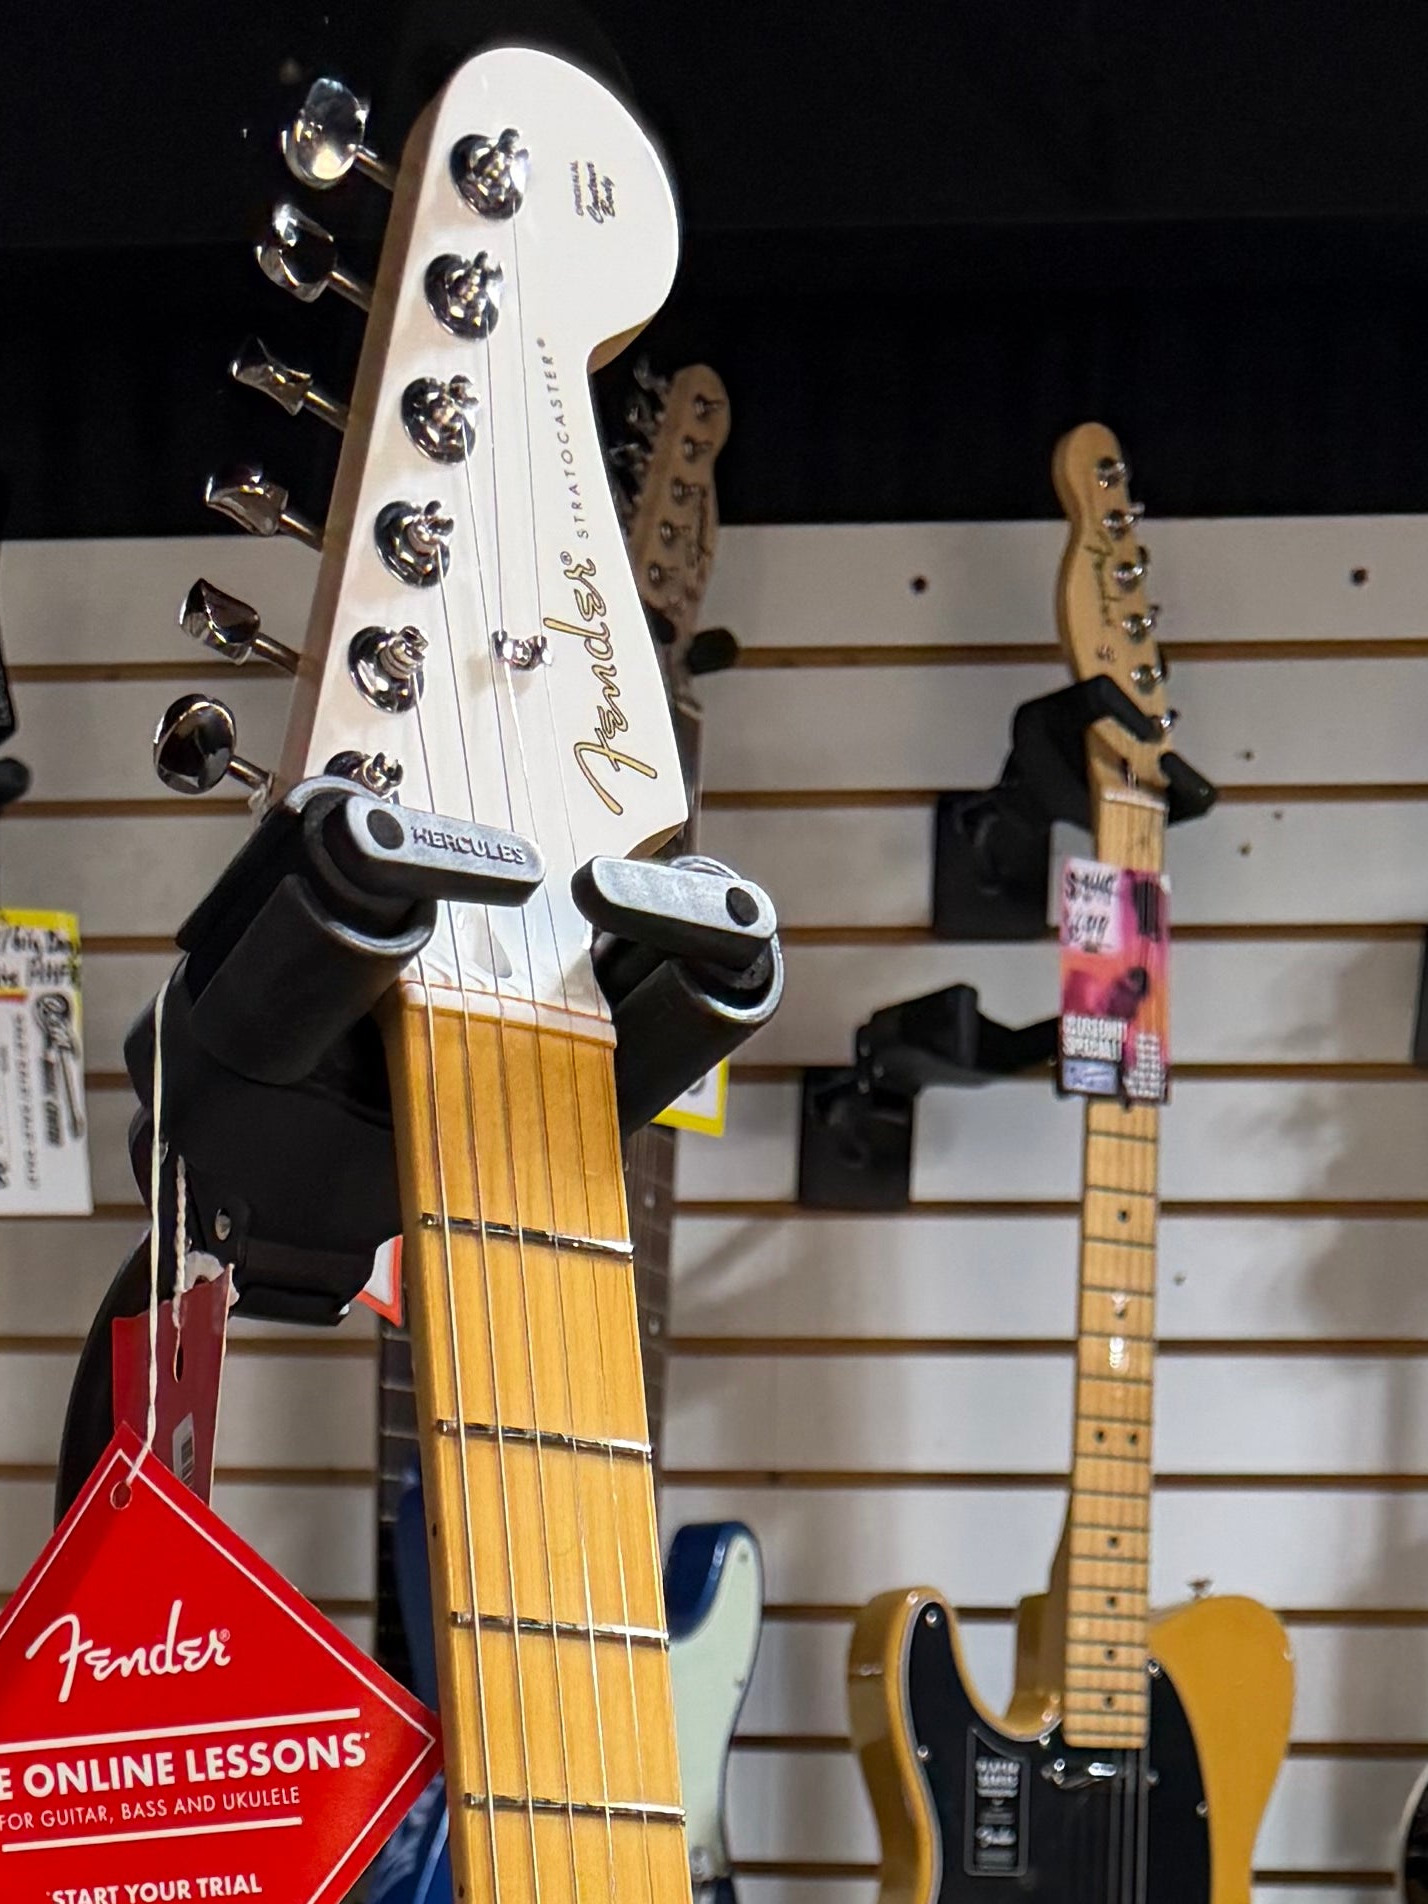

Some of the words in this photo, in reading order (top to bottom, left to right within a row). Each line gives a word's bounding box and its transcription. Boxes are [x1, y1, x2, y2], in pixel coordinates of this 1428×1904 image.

[411, 826, 526, 866] HERCULES
[25, 1598, 232, 1704] Fender
[23, 1751, 176, 1798] ONLINE
[40, 1805, 113, 1827] GUITAR,
[121, 1799, 167, 1820] BASS
[173, 1794, 216, 1815] AND
[222, 1786, 300, 1811] UKULELE
[124, 1879, 192, 1904] YOUR
[195, 1873, 263, 1898] TRIAL
